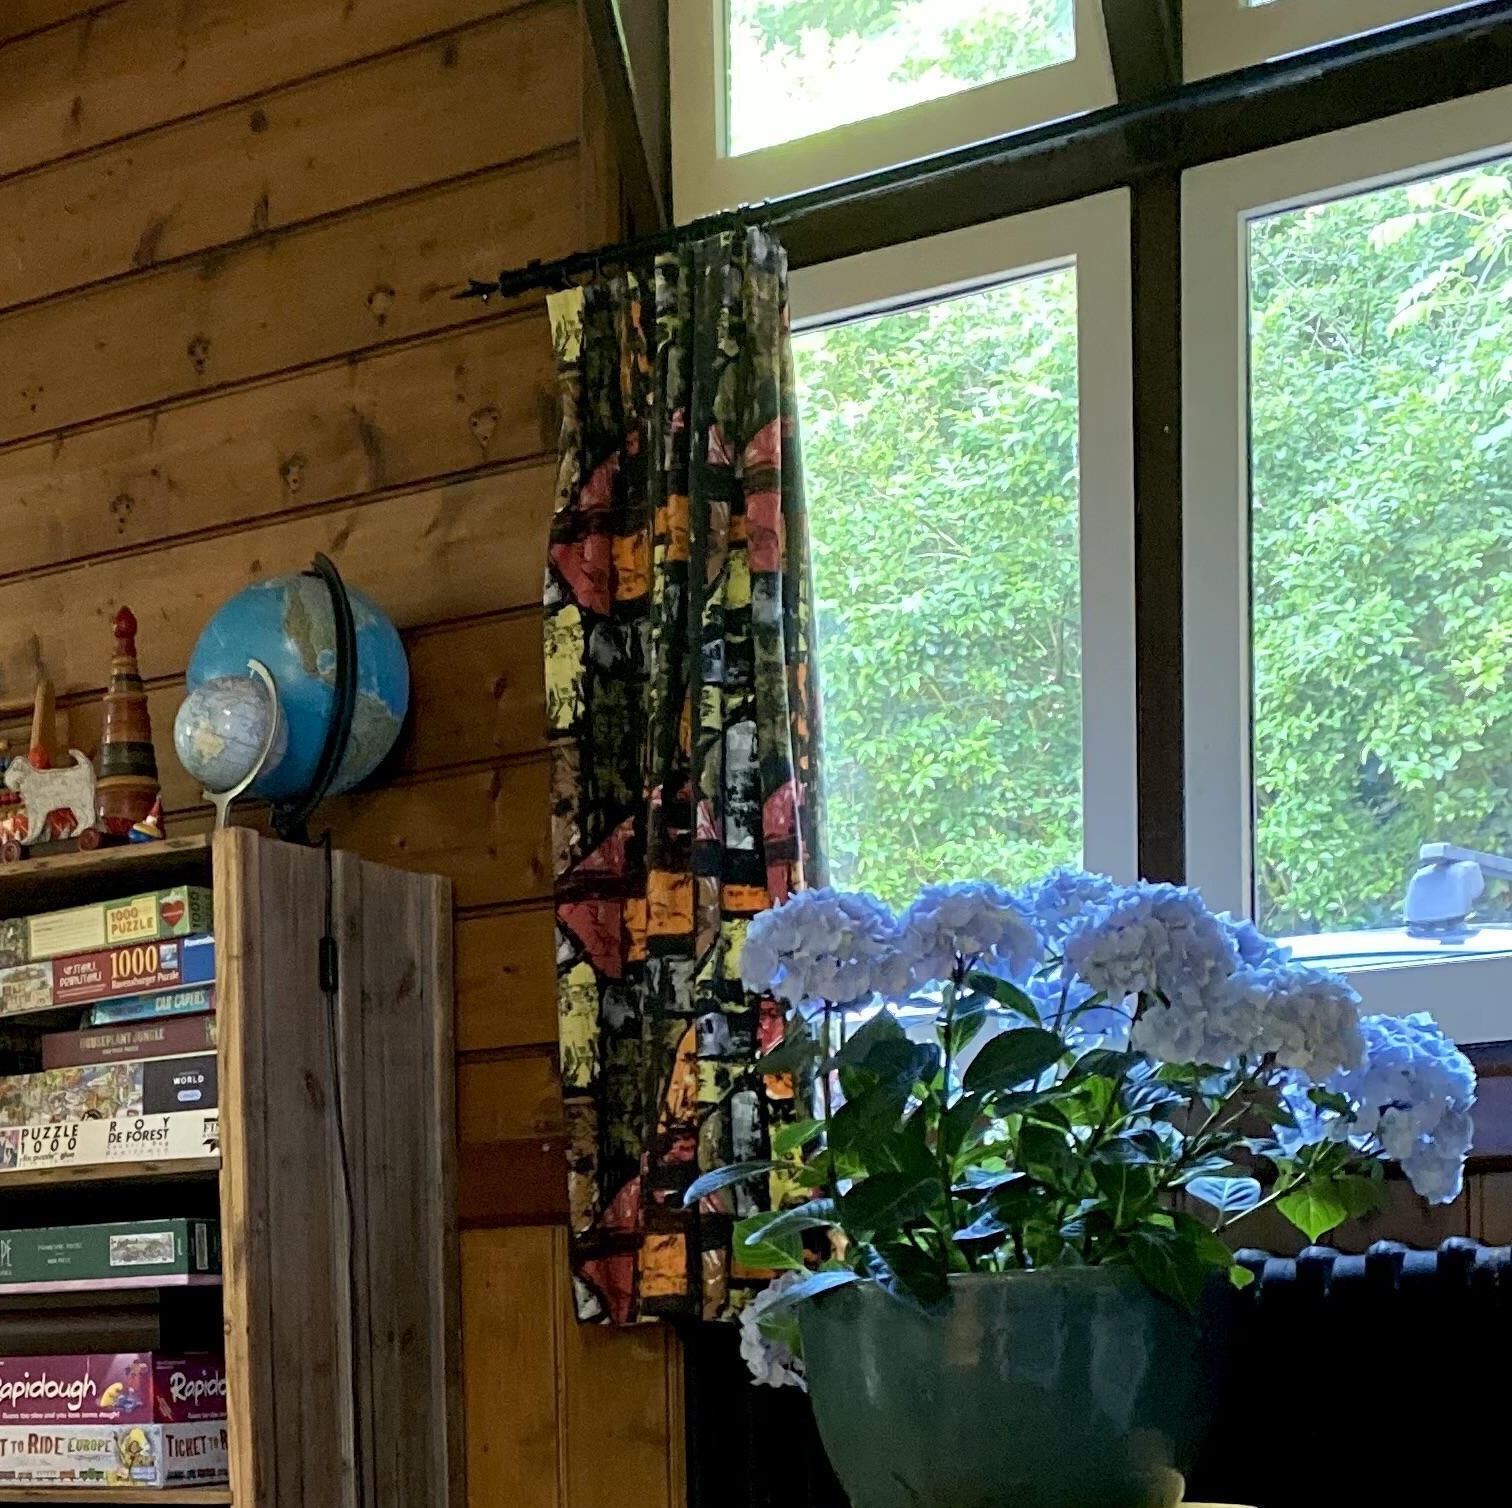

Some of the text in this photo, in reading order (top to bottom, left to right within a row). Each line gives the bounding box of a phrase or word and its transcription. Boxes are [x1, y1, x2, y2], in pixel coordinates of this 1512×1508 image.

[110, 906, 138, 922] 1000
[111, 917, 154, 936] PUZZLE
[110, 945, 158, 979] 1000
[173, 1075, 205, 1086] WORLD
[21, 1124, 79, 1140] PUZZLE
[108, 1128, 169, 1144] DE FOREST
[21, 1137, 77, 1154] 1000
[11, 1440, 24, 1455] TO
[27, 1432, 65, 1455] RIDE
[67, 1437, 112, 1454] EUROPE
[165, 1434, 207, 1458] TICKET
